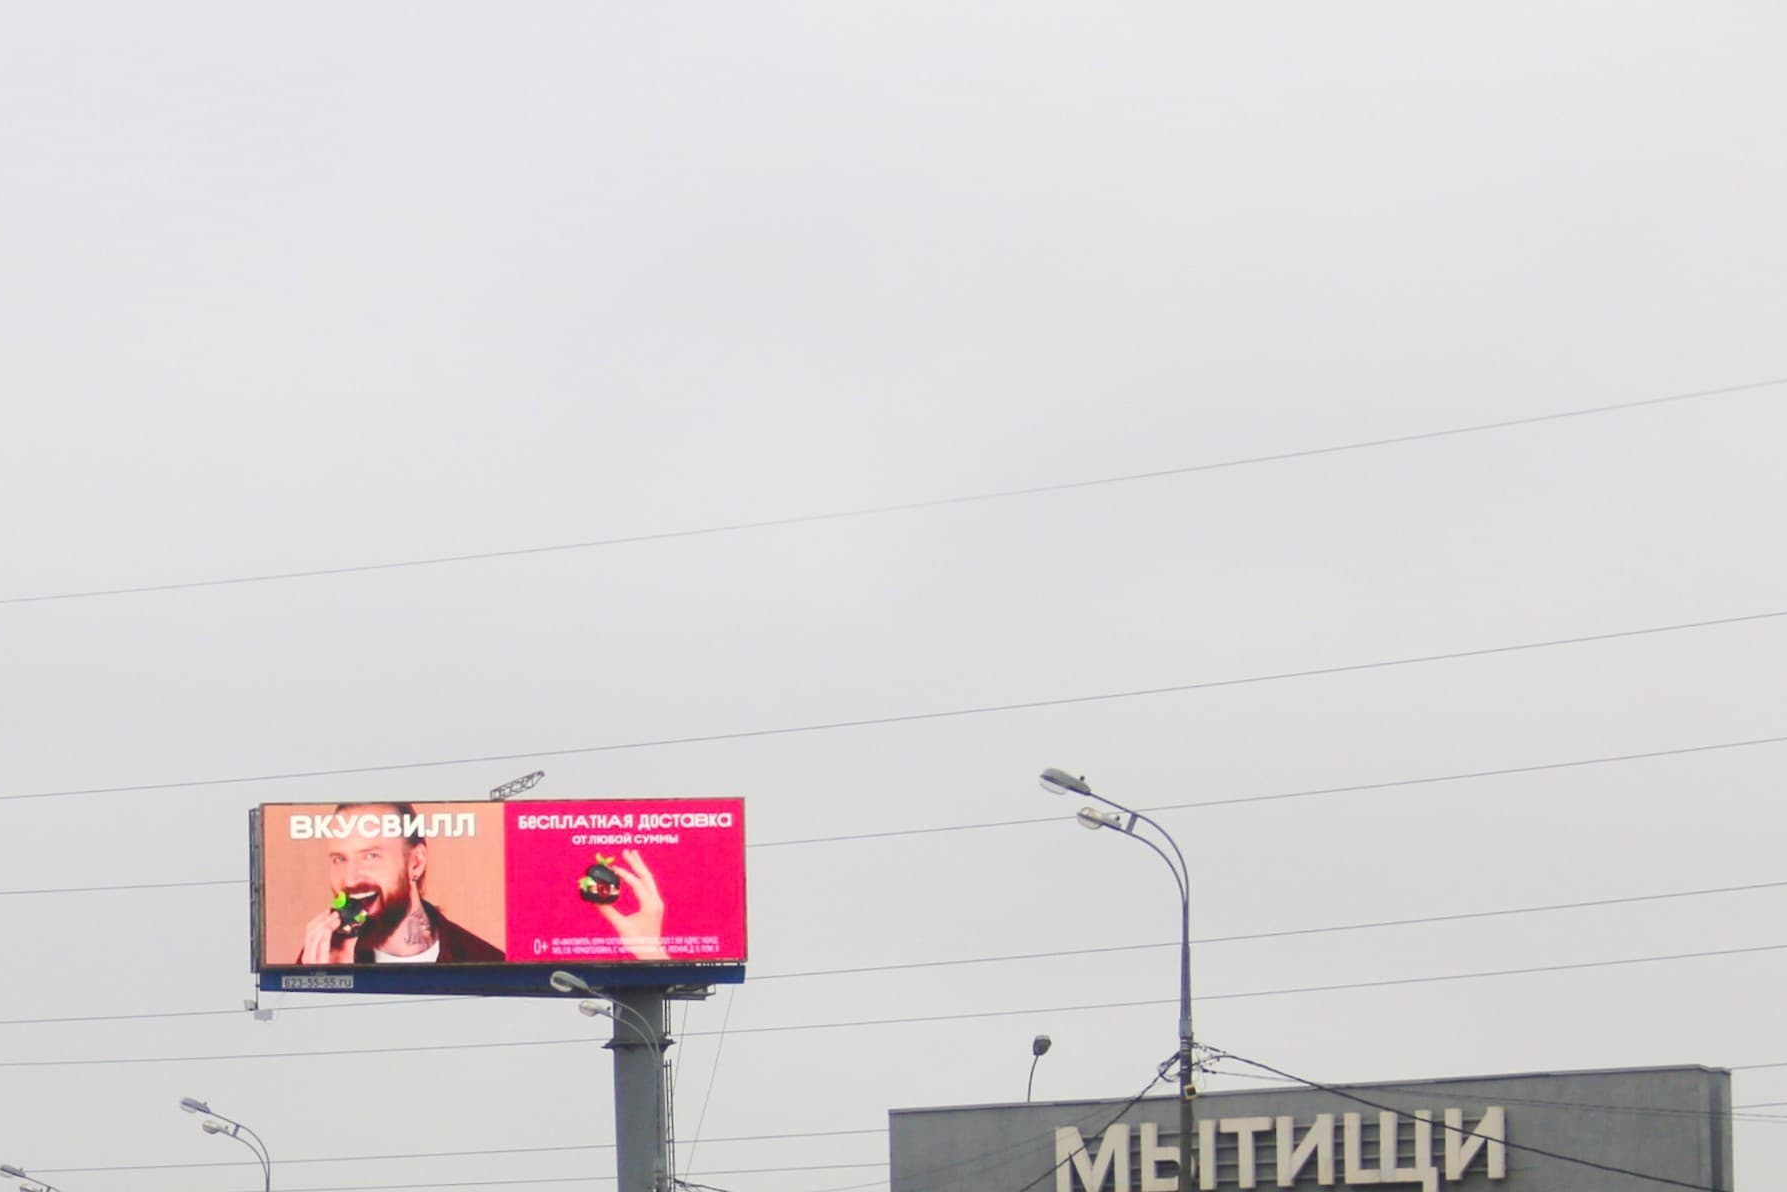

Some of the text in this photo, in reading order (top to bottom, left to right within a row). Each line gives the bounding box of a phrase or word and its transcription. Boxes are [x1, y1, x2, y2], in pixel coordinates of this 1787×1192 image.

[289, 813, 476, 839] ВКУСВИЛЛ
[572, 833, 679, 845] ОТ ЛЮБОЙ СУММЫ
[533, 938, 548, 955] 0+
